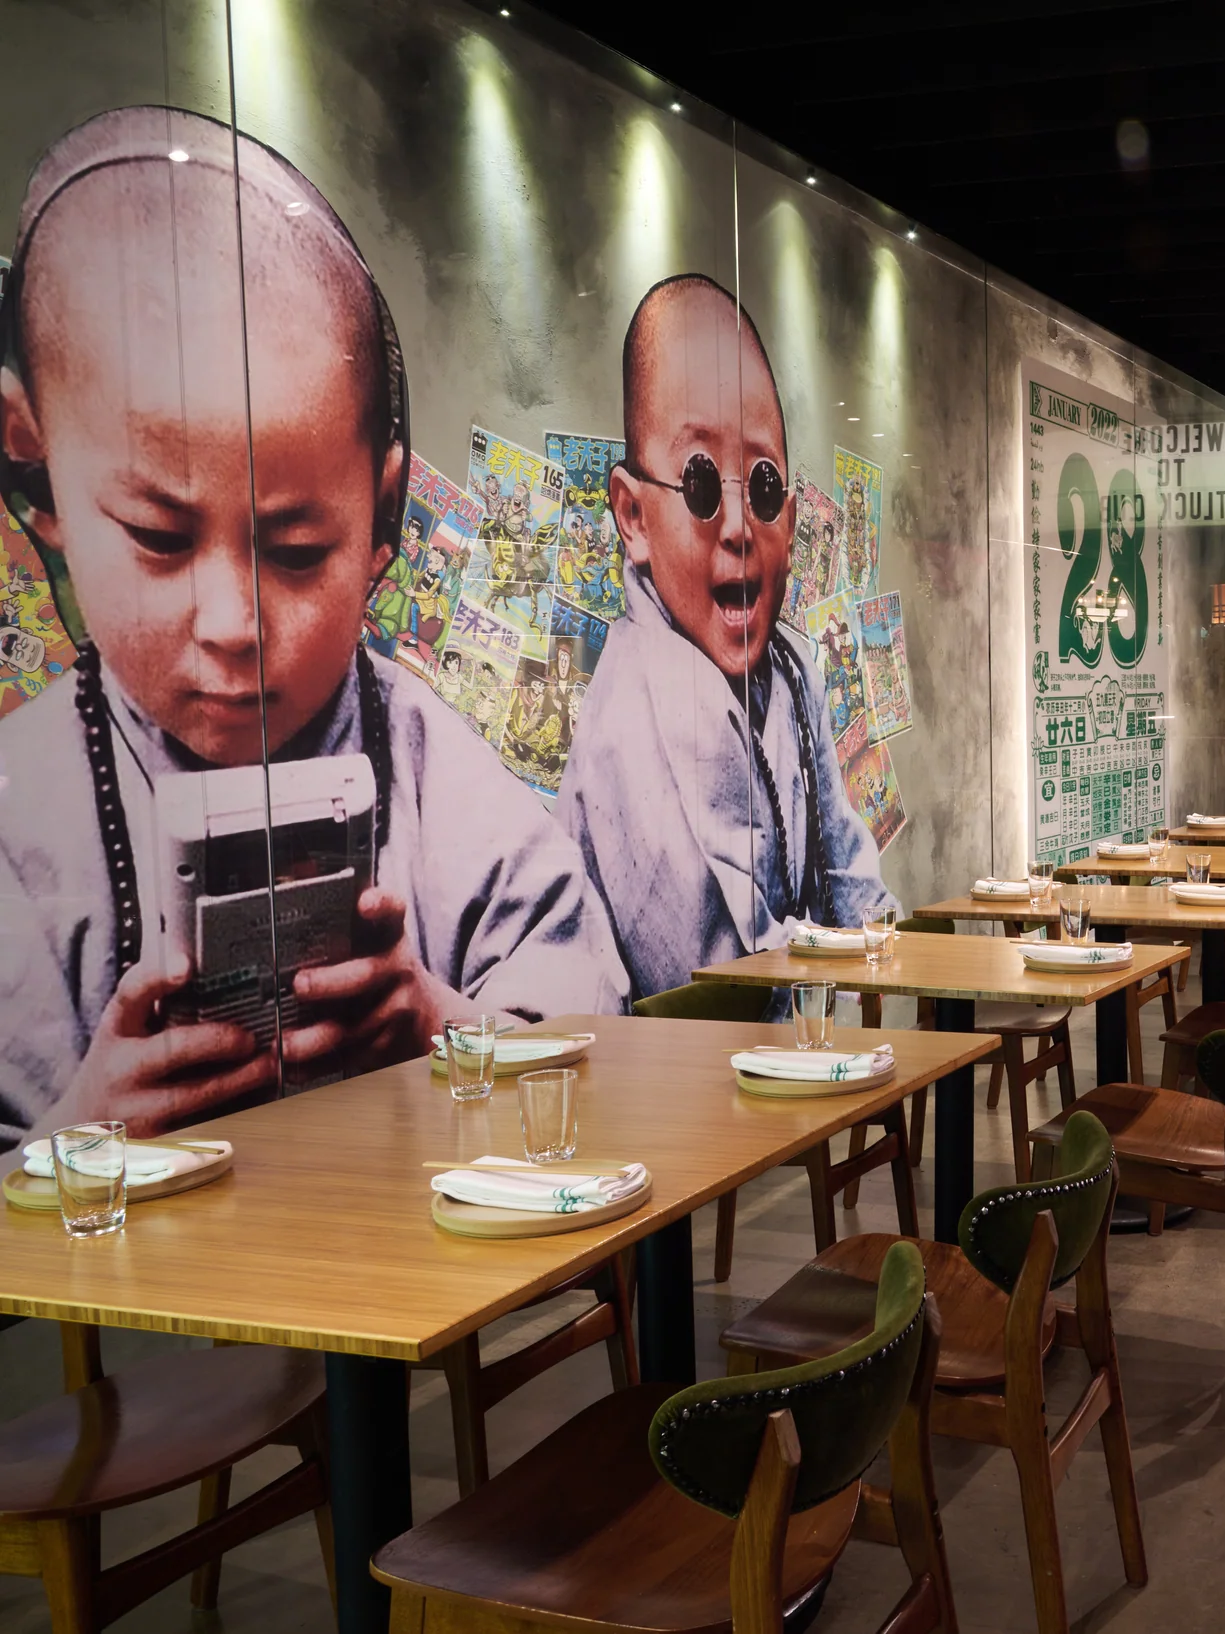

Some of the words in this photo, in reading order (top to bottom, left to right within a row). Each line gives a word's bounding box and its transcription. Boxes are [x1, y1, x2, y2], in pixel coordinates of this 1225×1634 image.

[1048, 395, 1082, 426] JANUARY
[1090, 406, 1118, 445] 2022
[487, 440, 544, 491] 老夫子
[543, 465, 564, 490] 165
[562, 437, 609, 473] 老夫子
[1057, 452, 1149, 670] 28
[1045, 715, 1086, 746] 廿六日
[1126, 711, 1157, 737] 星期五
[1044, 783, 1053, 798] 宜
[1103, 798, 1111, 809] 金
